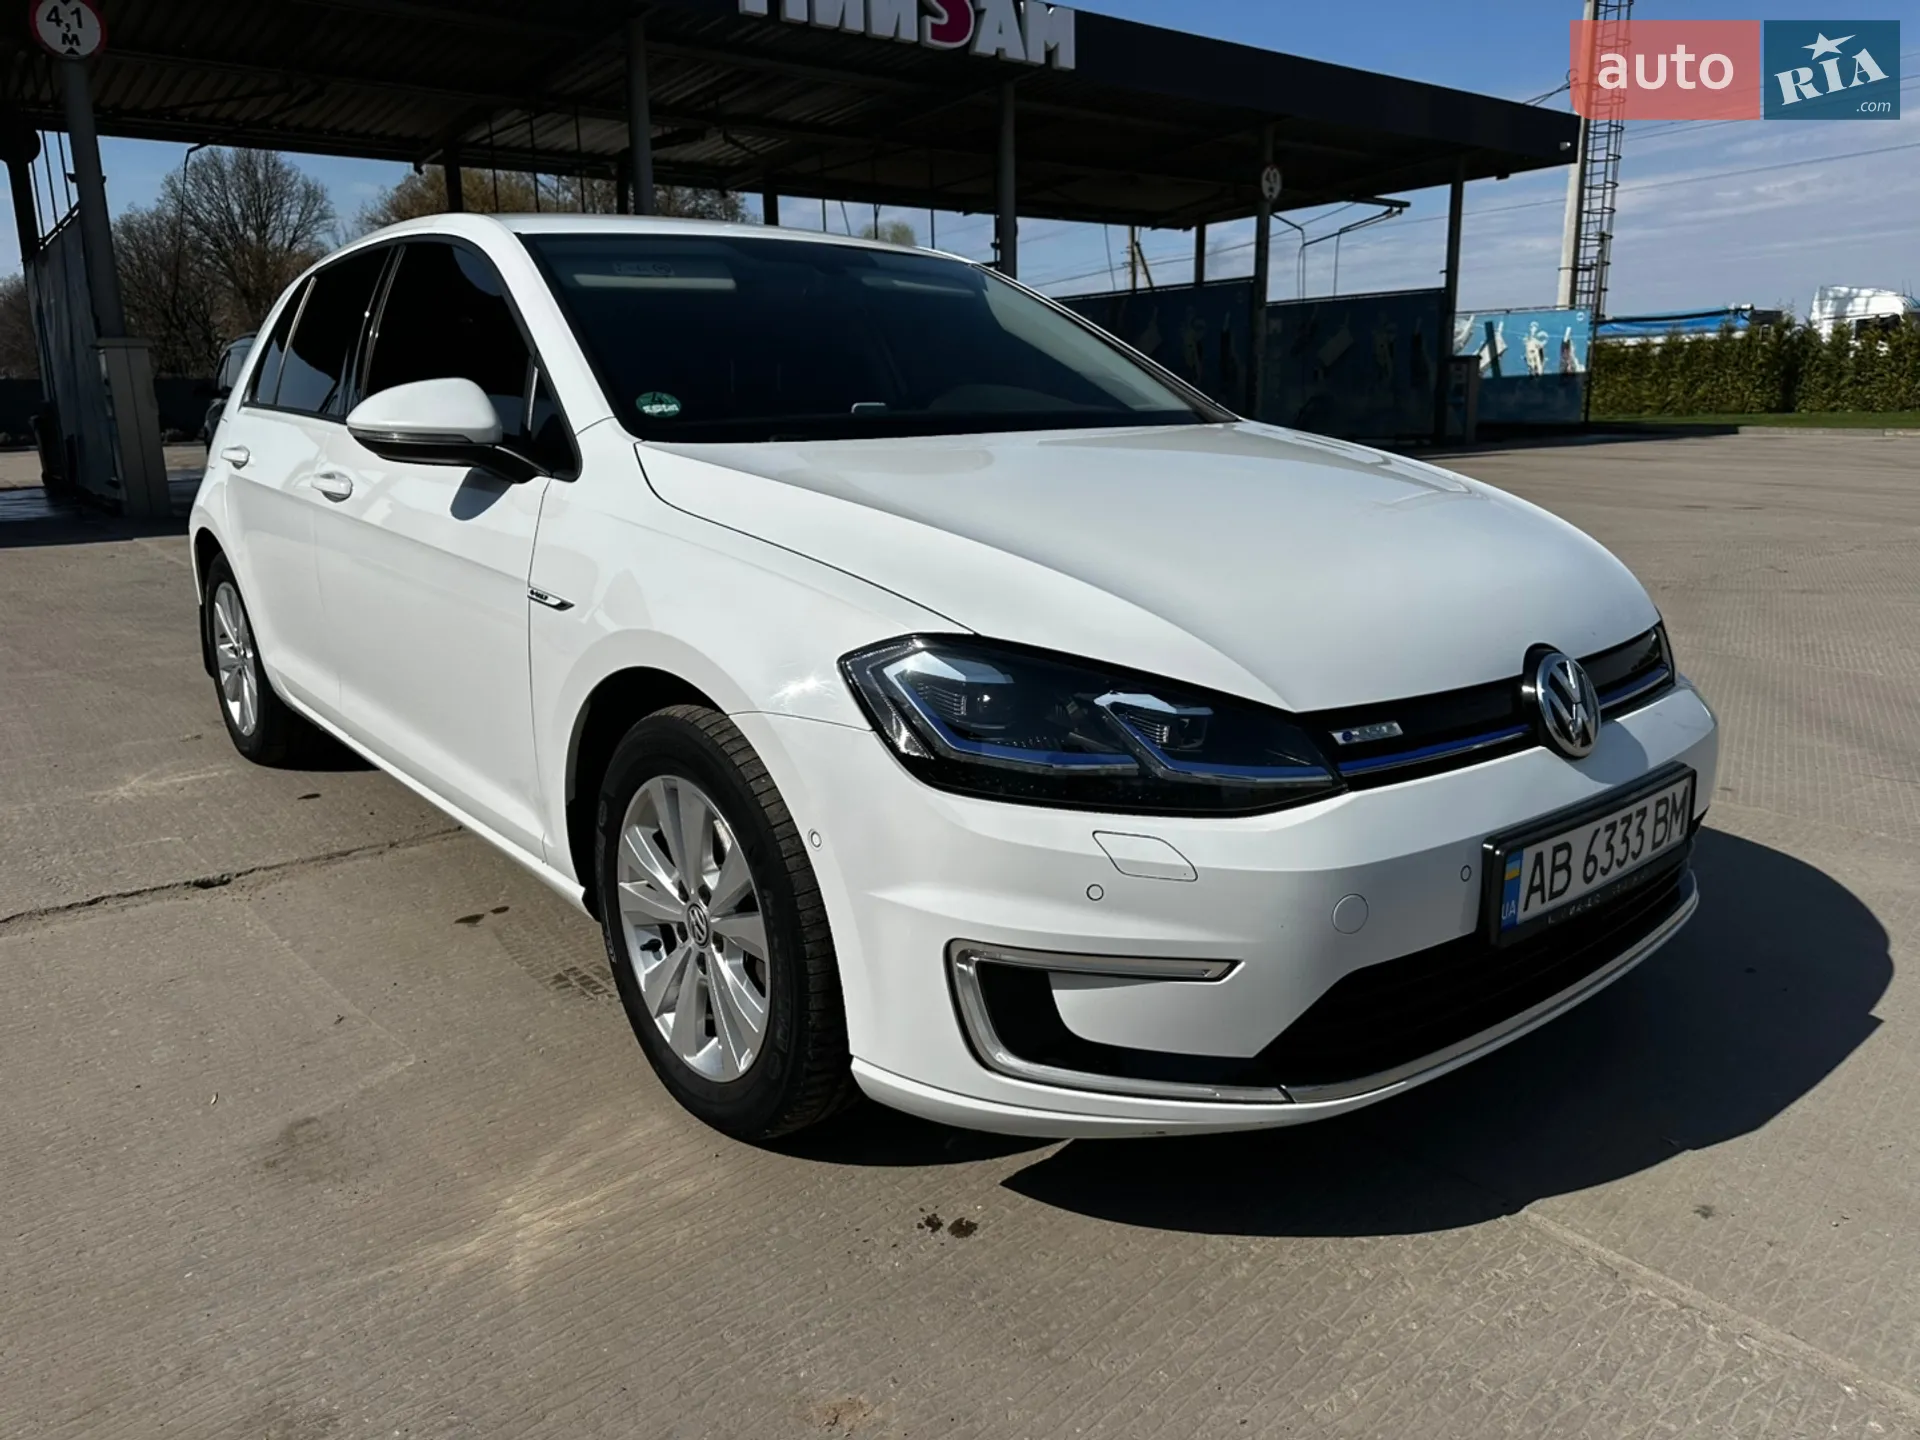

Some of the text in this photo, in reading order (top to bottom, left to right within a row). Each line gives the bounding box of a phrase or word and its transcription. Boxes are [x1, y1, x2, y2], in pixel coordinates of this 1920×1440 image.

[46, 5, 83, 33] 4,1
[738, 0, 1076, 70] SAM
[1523, 841, 1573, 912] AB
[1582, 806, 1648, 885] 6333
[1651, 785, 1689, 851] BM
[1501, 899, 1516, 919] UA
